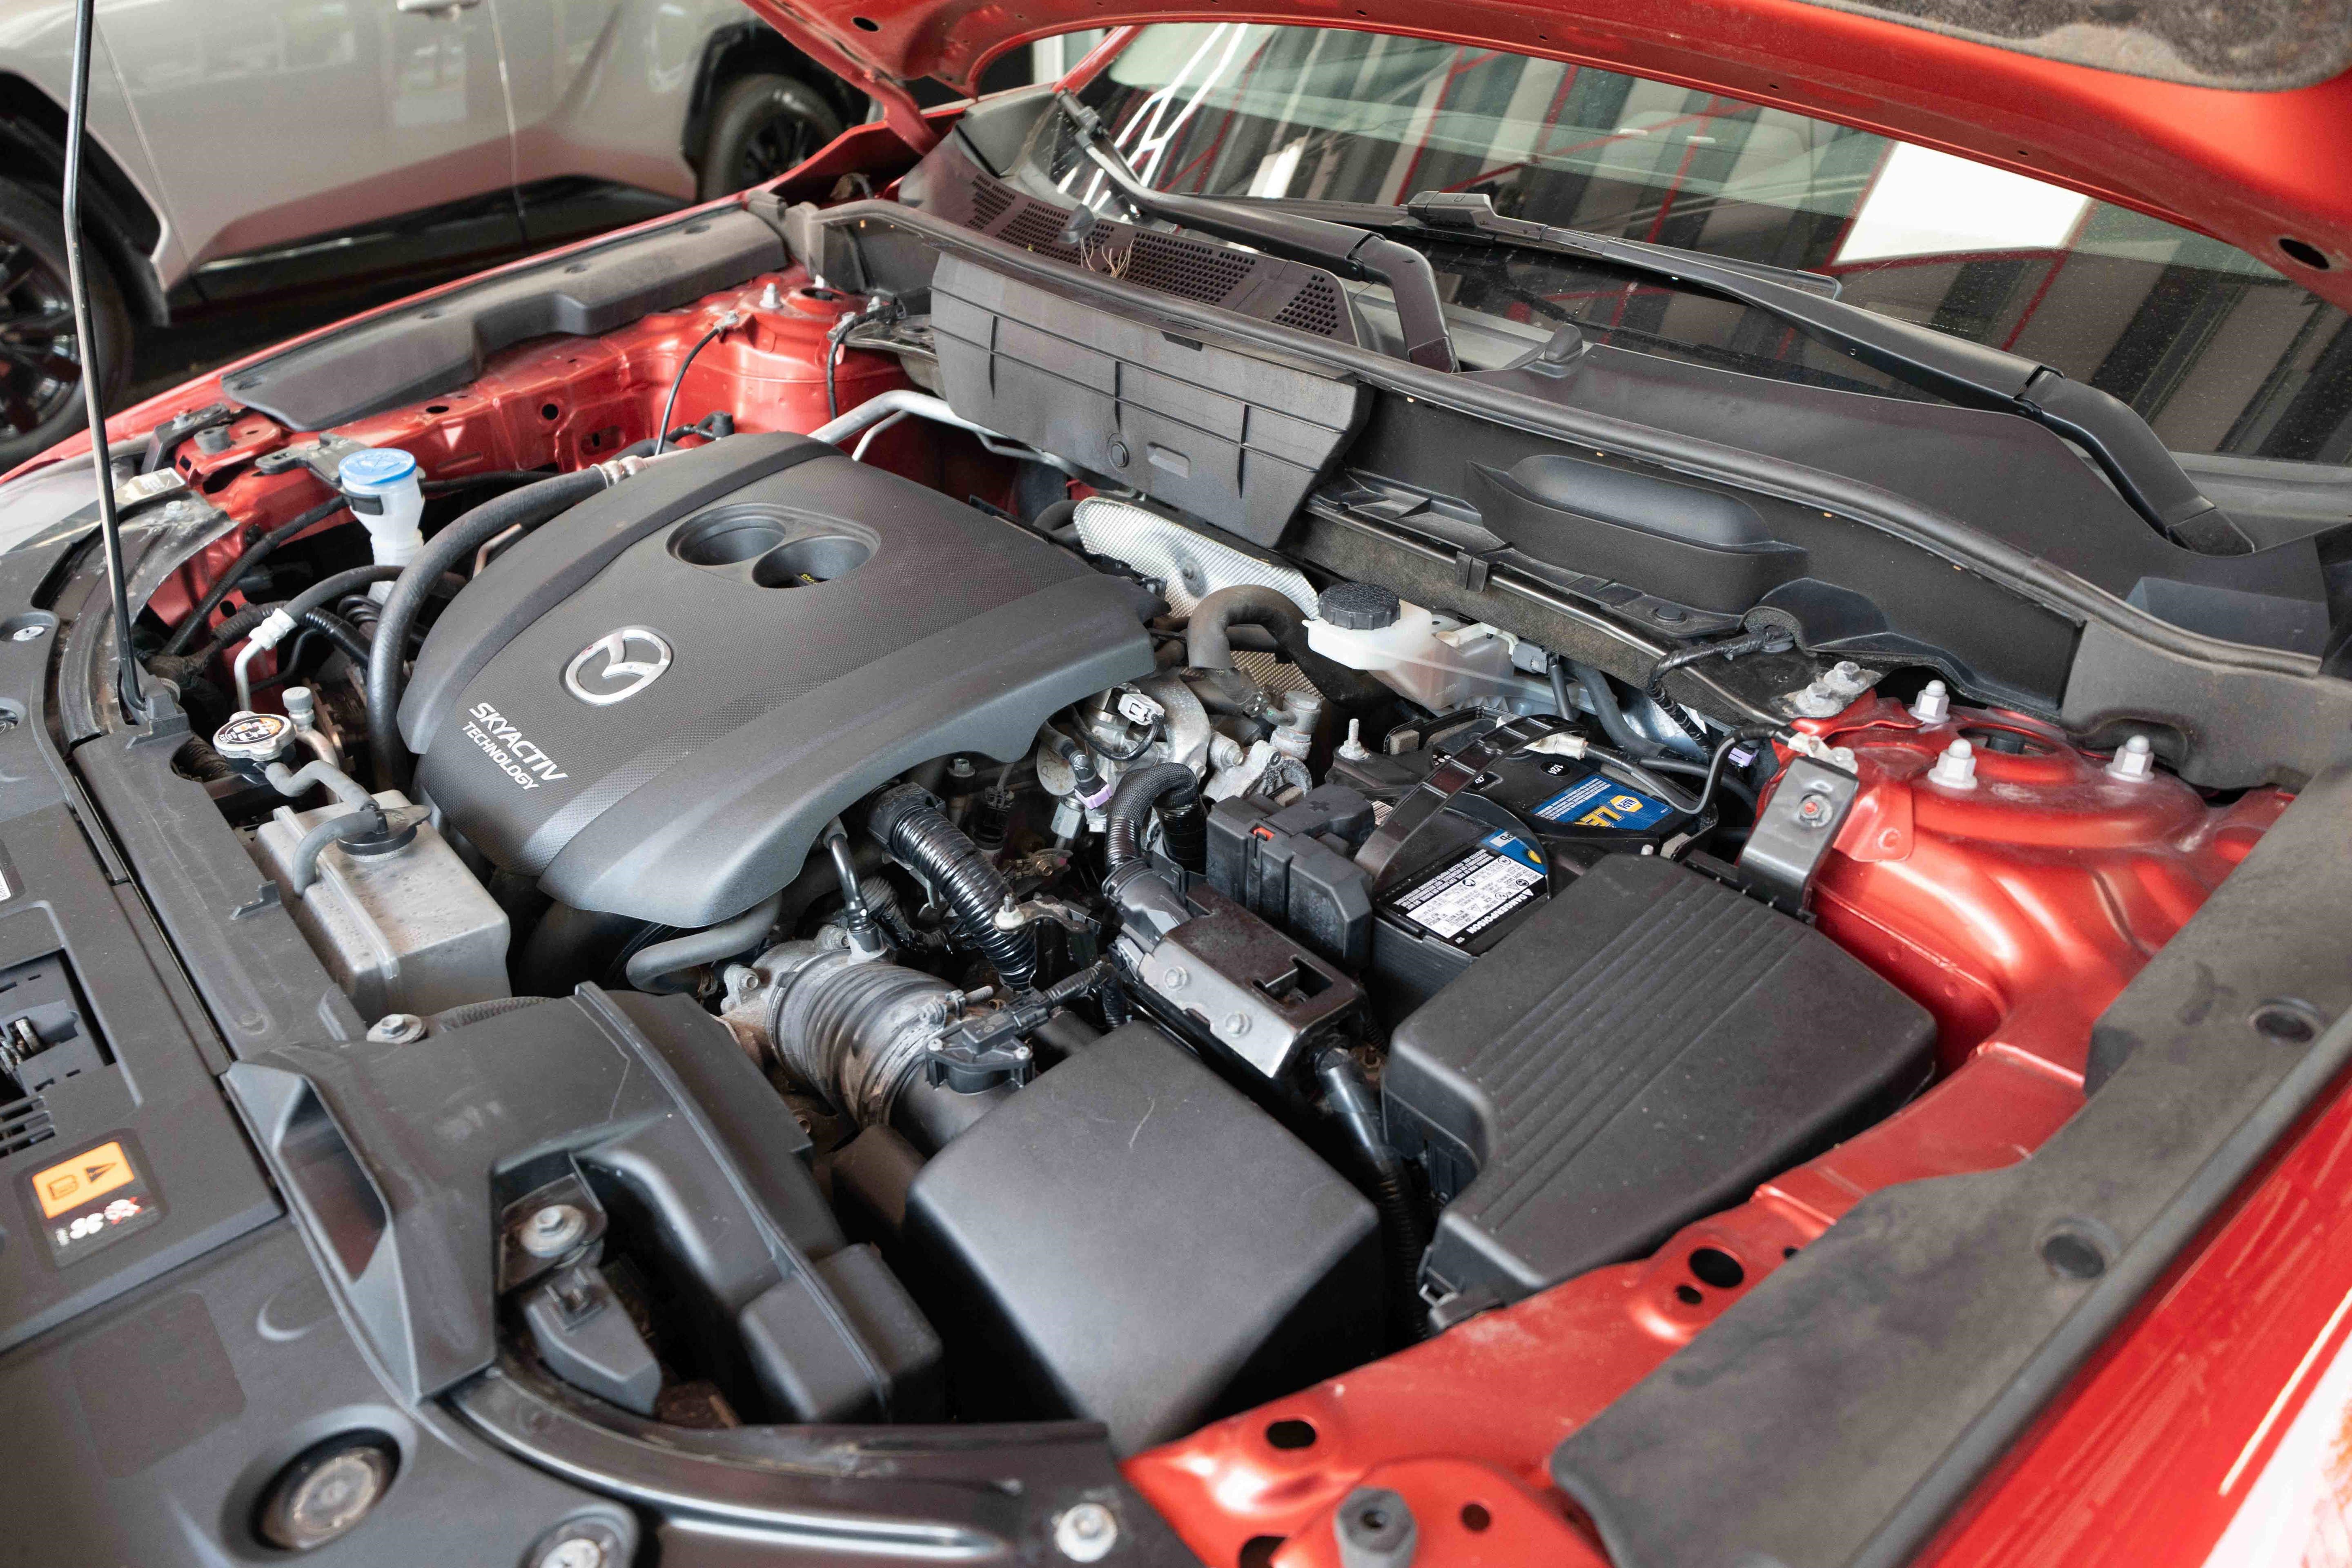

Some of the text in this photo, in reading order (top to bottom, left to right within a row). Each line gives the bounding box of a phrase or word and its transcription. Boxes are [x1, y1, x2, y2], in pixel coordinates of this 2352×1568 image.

[462, 722, 539, 790] TECHNOLOGY
[469, 703, 568, 782] SKYACTIV
[1548, 764, 1564, 774] 1/24
[1616, 798, 1637, 809] NAPA
[1466, 894, 1528, 934] DANGER/POISON
